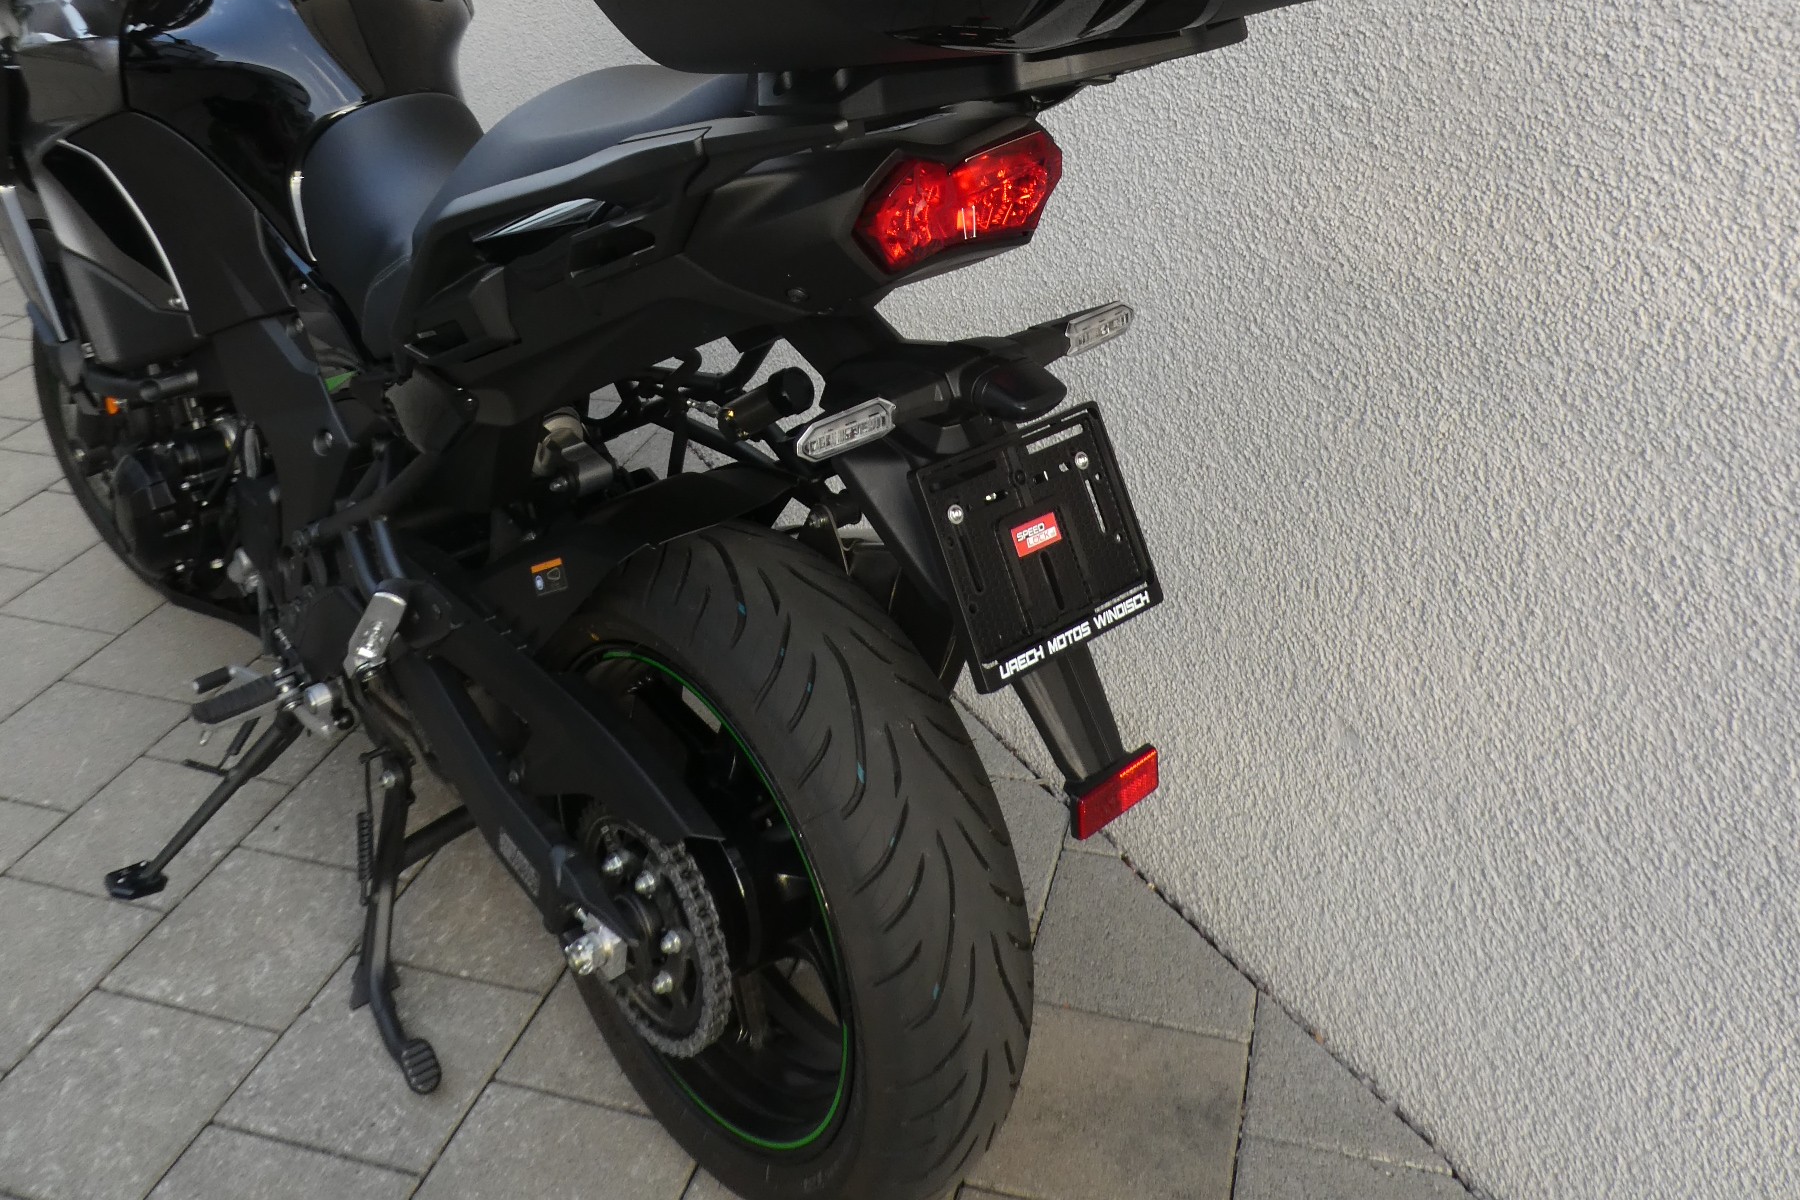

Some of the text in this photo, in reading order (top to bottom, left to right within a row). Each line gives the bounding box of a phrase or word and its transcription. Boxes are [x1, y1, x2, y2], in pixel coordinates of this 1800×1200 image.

[1016, 522, 1045, 542] SPEED
[1027, 530, 1050, 546] LOCK
[999, 590, 1150, 680] URECH MOTOS WINDISCH
